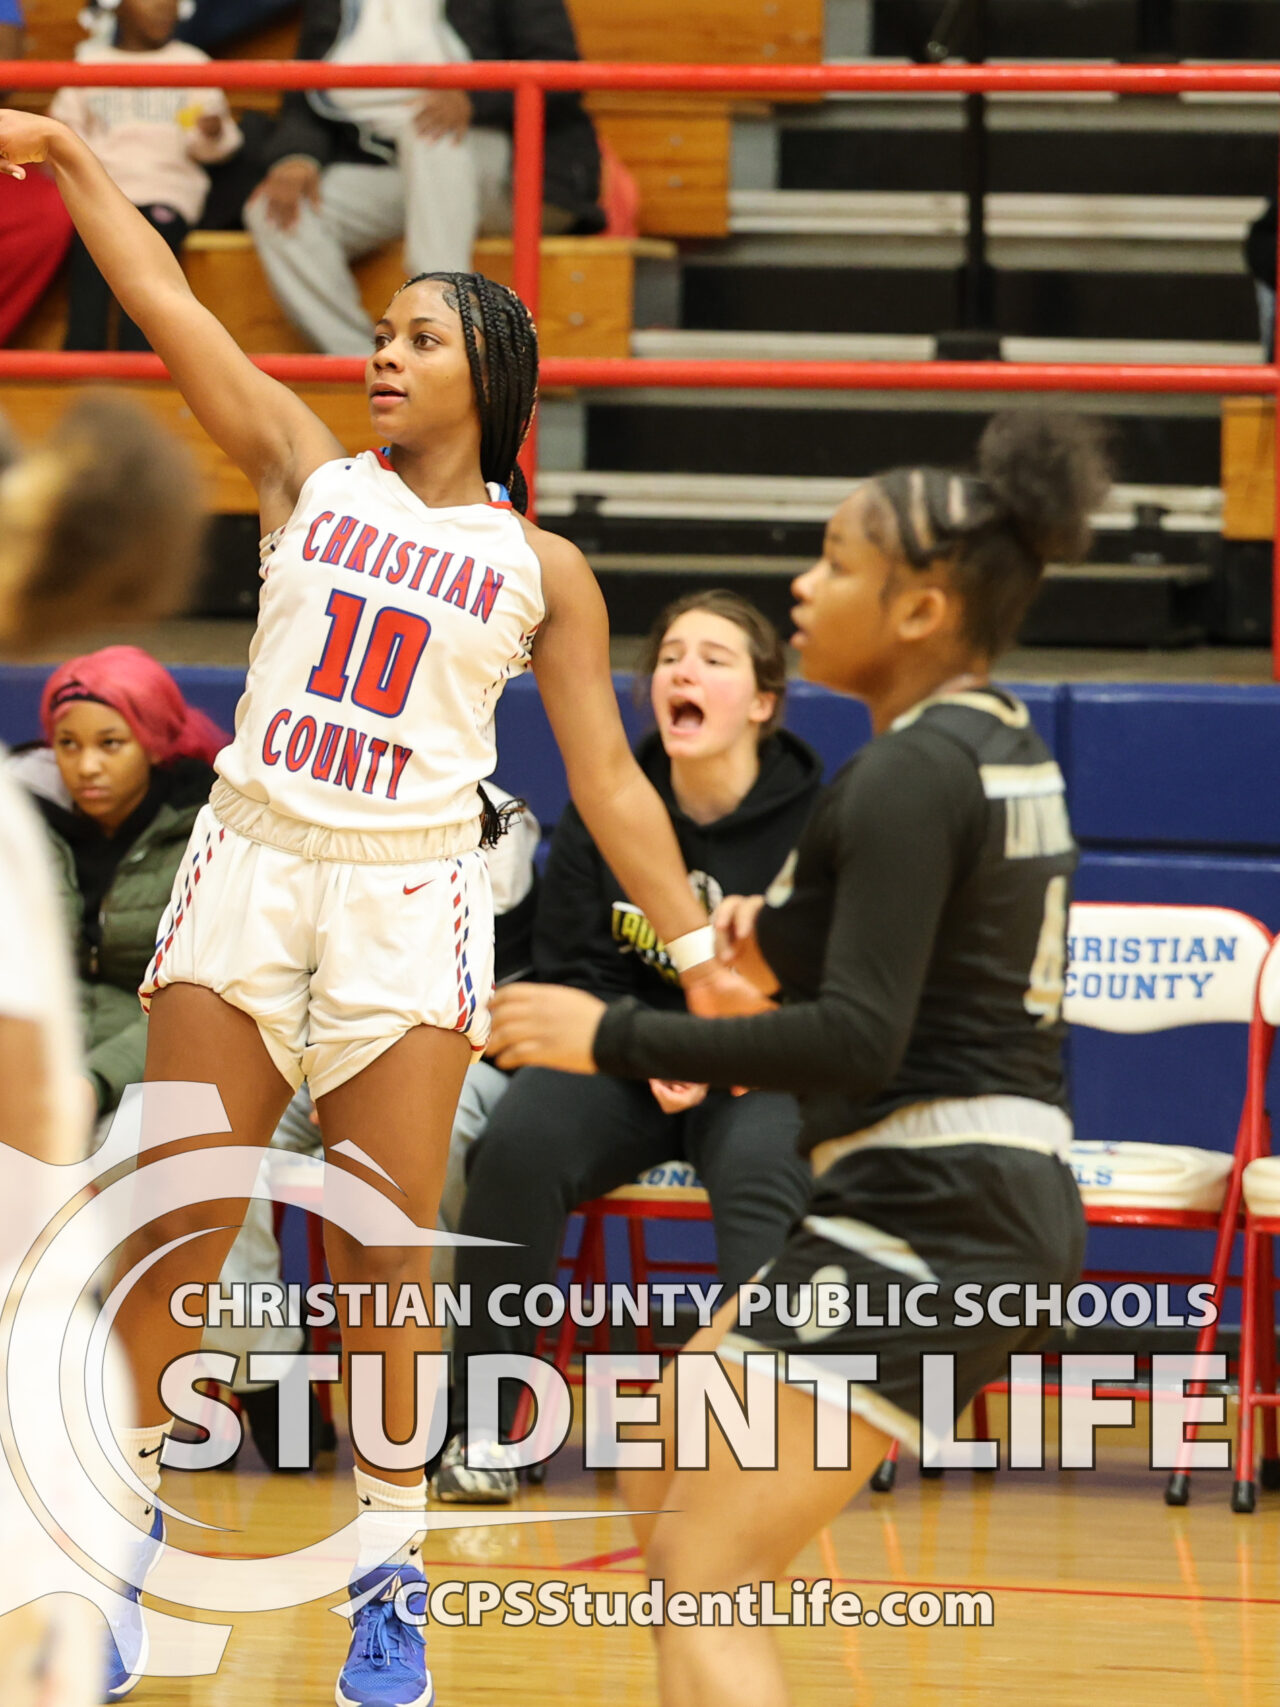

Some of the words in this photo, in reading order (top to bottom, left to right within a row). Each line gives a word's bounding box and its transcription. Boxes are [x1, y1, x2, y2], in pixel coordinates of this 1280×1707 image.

[302, 510, 505, 624] CHRISTIAN
[305, 588, 432, 718] 10
[262, 709, 413, 800] COUNTY
[1063, 972, 1214, 999] COUNTY
